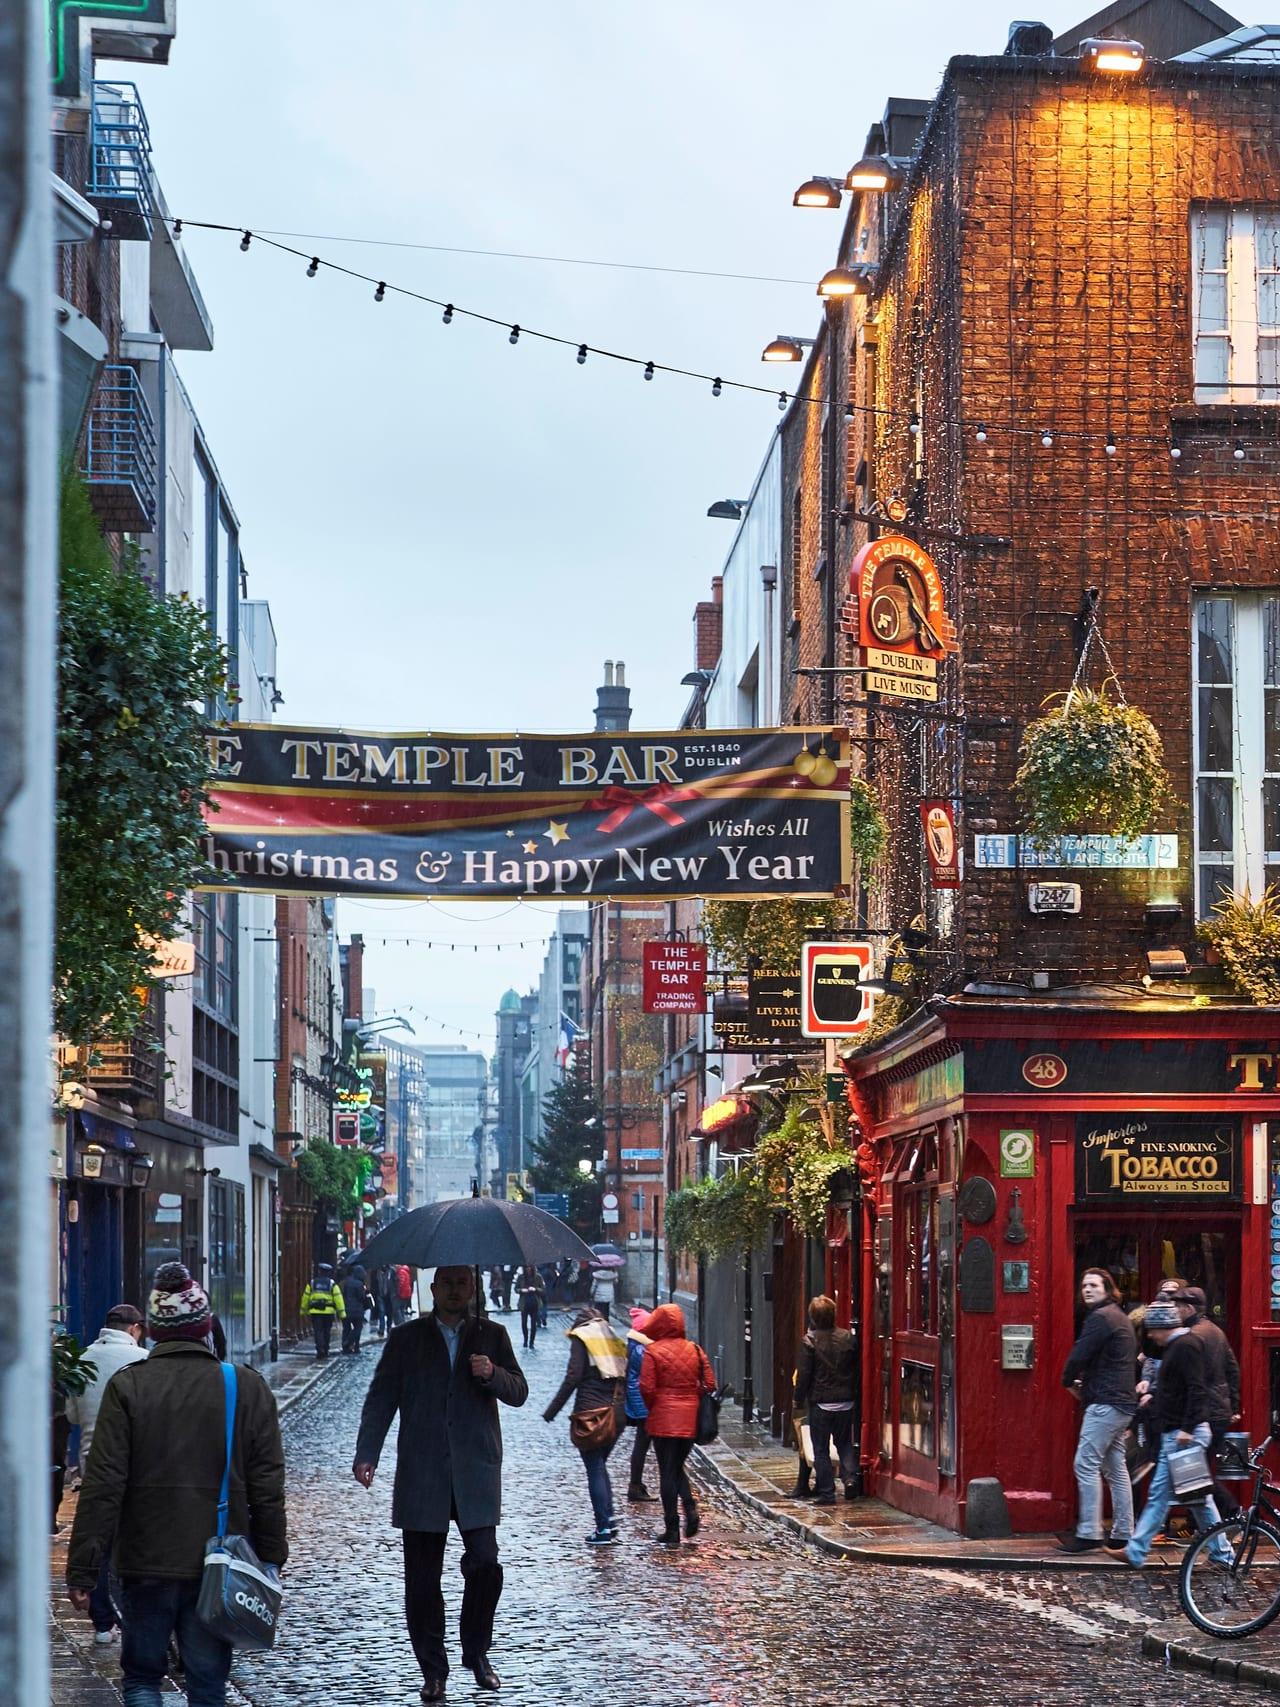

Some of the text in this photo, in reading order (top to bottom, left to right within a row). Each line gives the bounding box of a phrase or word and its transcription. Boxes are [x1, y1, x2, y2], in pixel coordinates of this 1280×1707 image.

[862, 542, 940, 612] THE TEMPLE BAR
[881, 653, 923, 671] DUBLIN
[874, 676, 932, 697] LIVE MUSIC
[280, 738, 524, 787] TEMPLE
[558, 745, 683, 785] BAR
[685, 756, 741, 767] DUBLIN
[708, 818, 809, 838] Wishes All
[1067, 853, 1099, 864] LANE
[204, 837, 814, 894] hristmas & Happy New Year
[663, 947, 689, 958] THE
[650, 960, 701, 971] TEMPLE
[753, 969, 801, 977] BEER GAR
[661, 974, 689, 984] BAR
[817, 977, 856, 986] GUINNESS
[653, 1001, 697, 1009] COMPANY
[756, 1007, 782, 1015] LIVE
[714, 1023, 748, 1033] DISTI
[1029, 1060, 1057, 1080] 48
[1082, 1121, 1148, 1149] Importers
[1124, 1137, 1136, 1145] OF
[1141, 1142, 1217, 1152] FINE SMOKING
[1100, 1148, 1218, 1188] TOBACCO
[1124, 1181, 1227, 1191] Always in Stock
[235, 1591, 274, 1626] adidas
